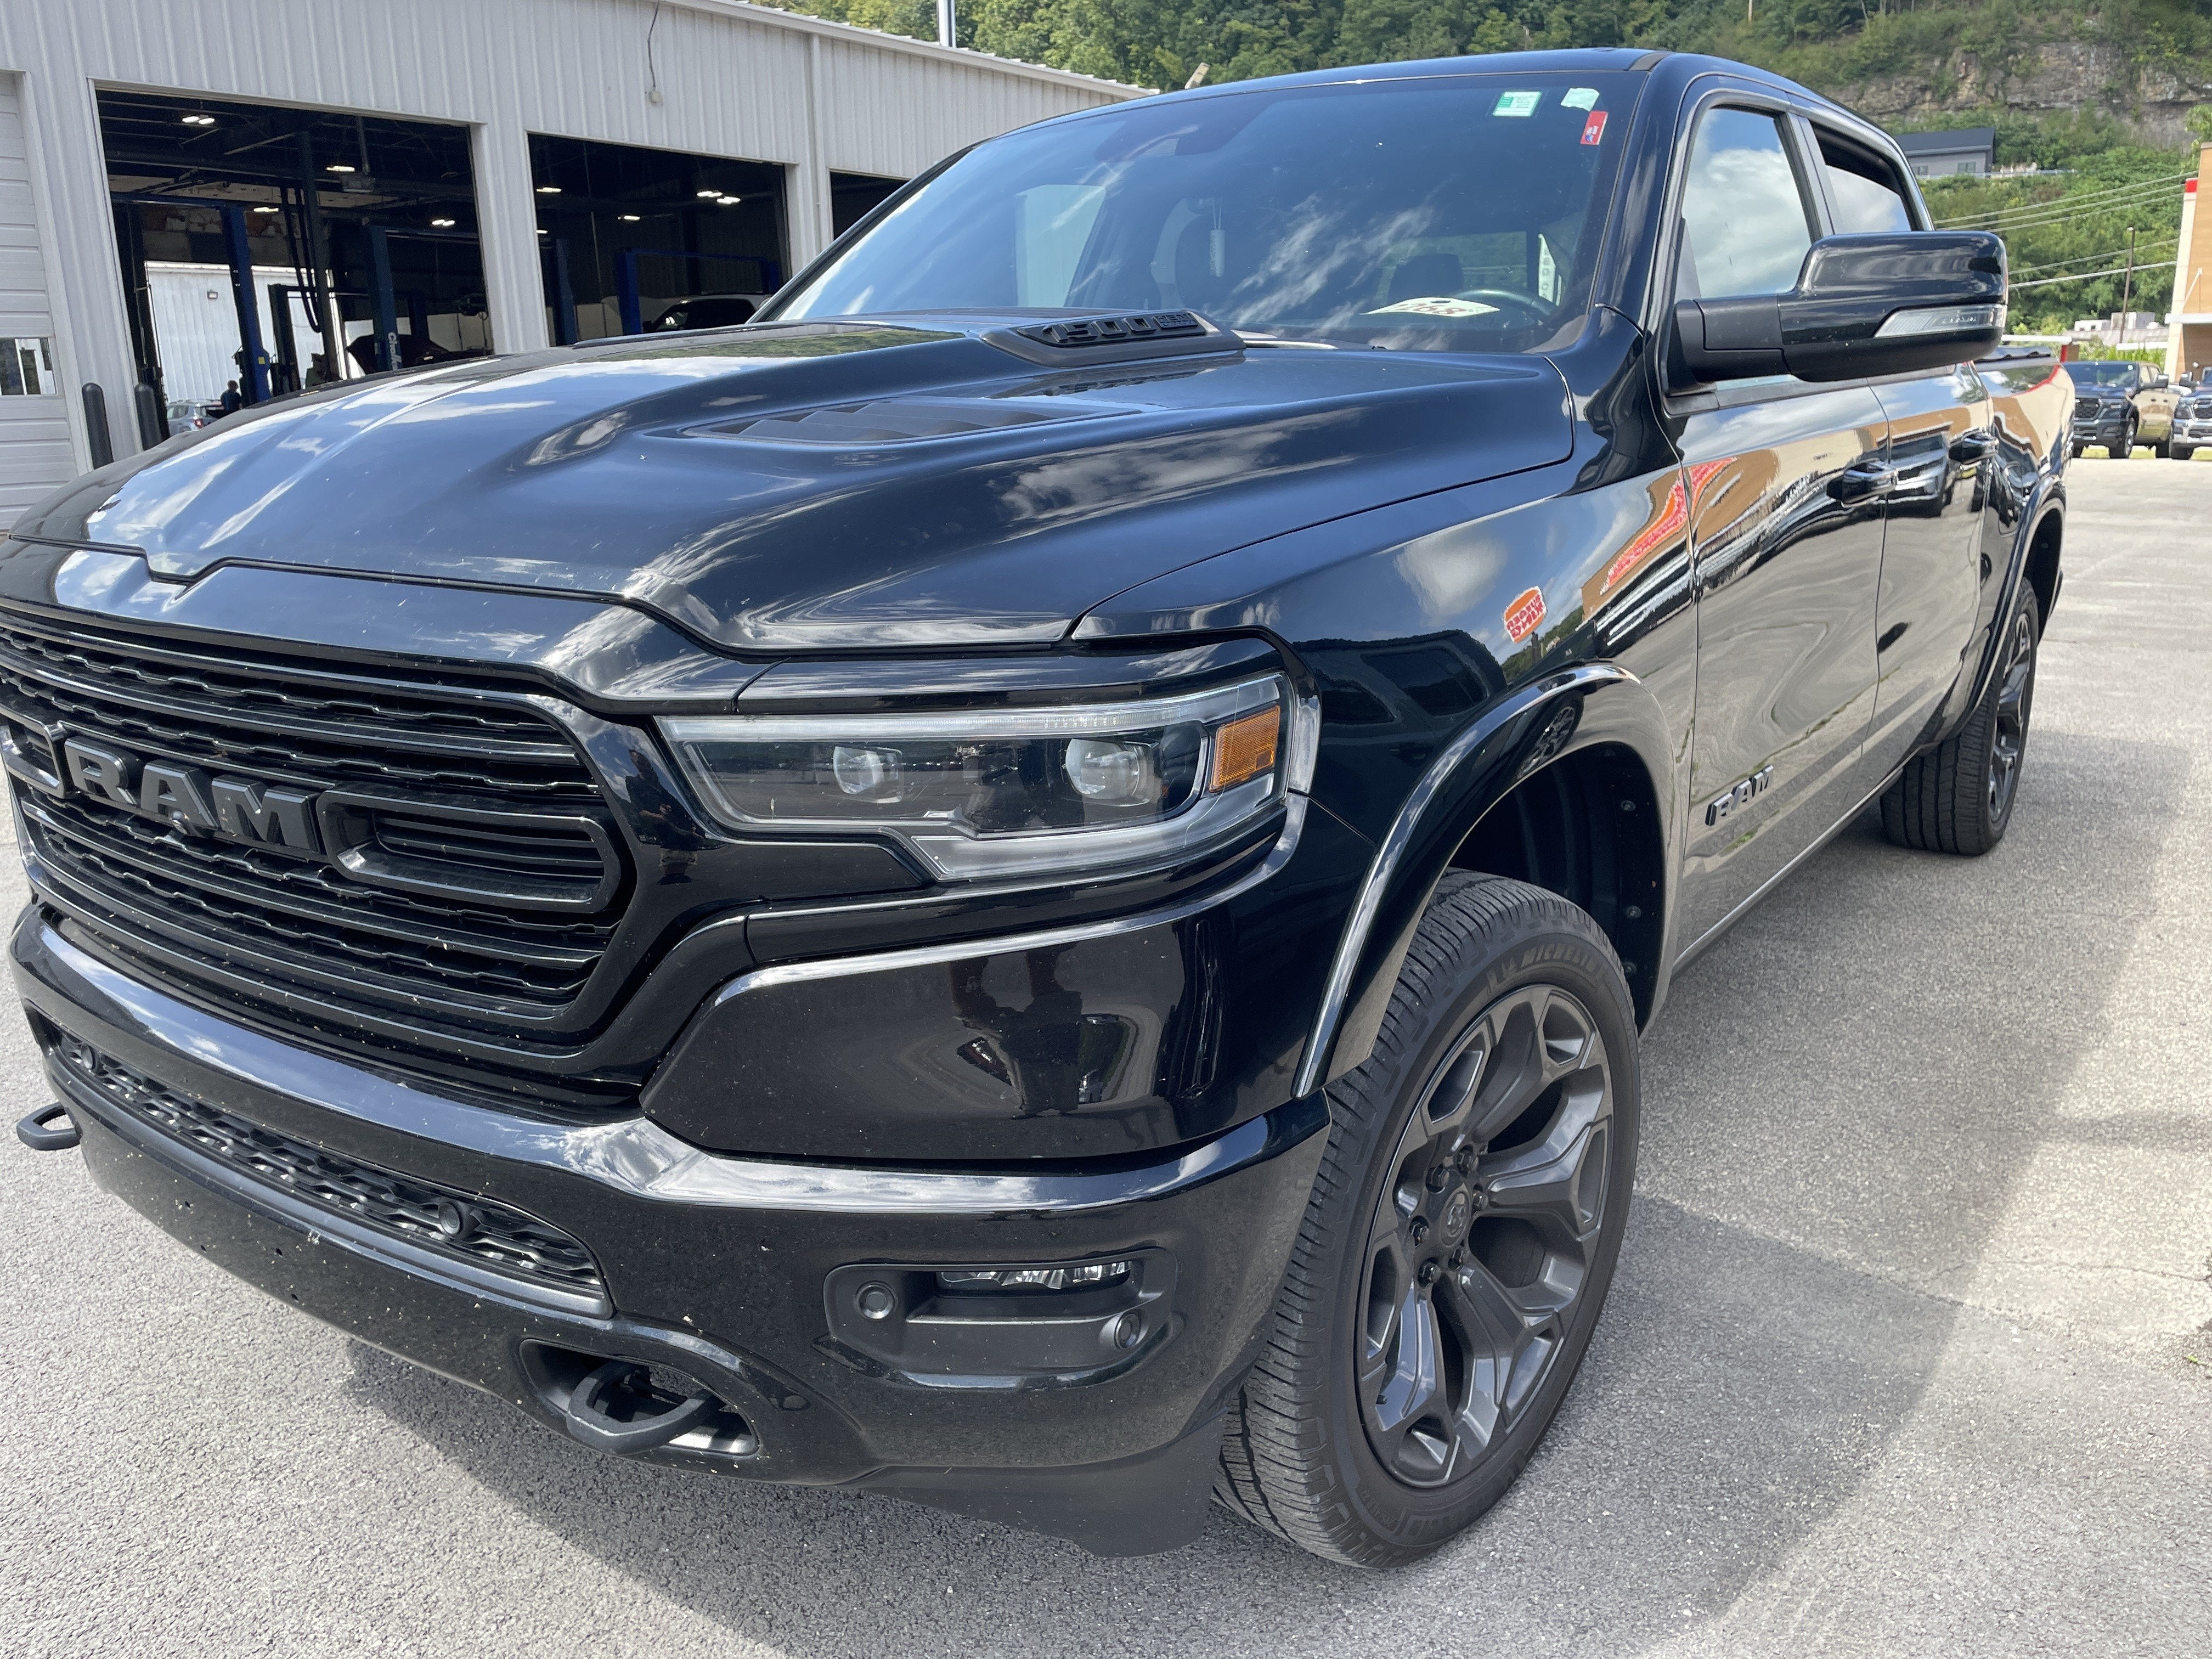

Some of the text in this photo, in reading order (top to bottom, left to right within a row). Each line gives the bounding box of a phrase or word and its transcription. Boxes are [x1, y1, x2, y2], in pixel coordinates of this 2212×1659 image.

[1042, 317, 1156, 342] 1500
[64, 735, 319, 853] RAM
[1705, 764, 1774, 826] RAM
[1521, 943, 1601, 973] MICHELIN
